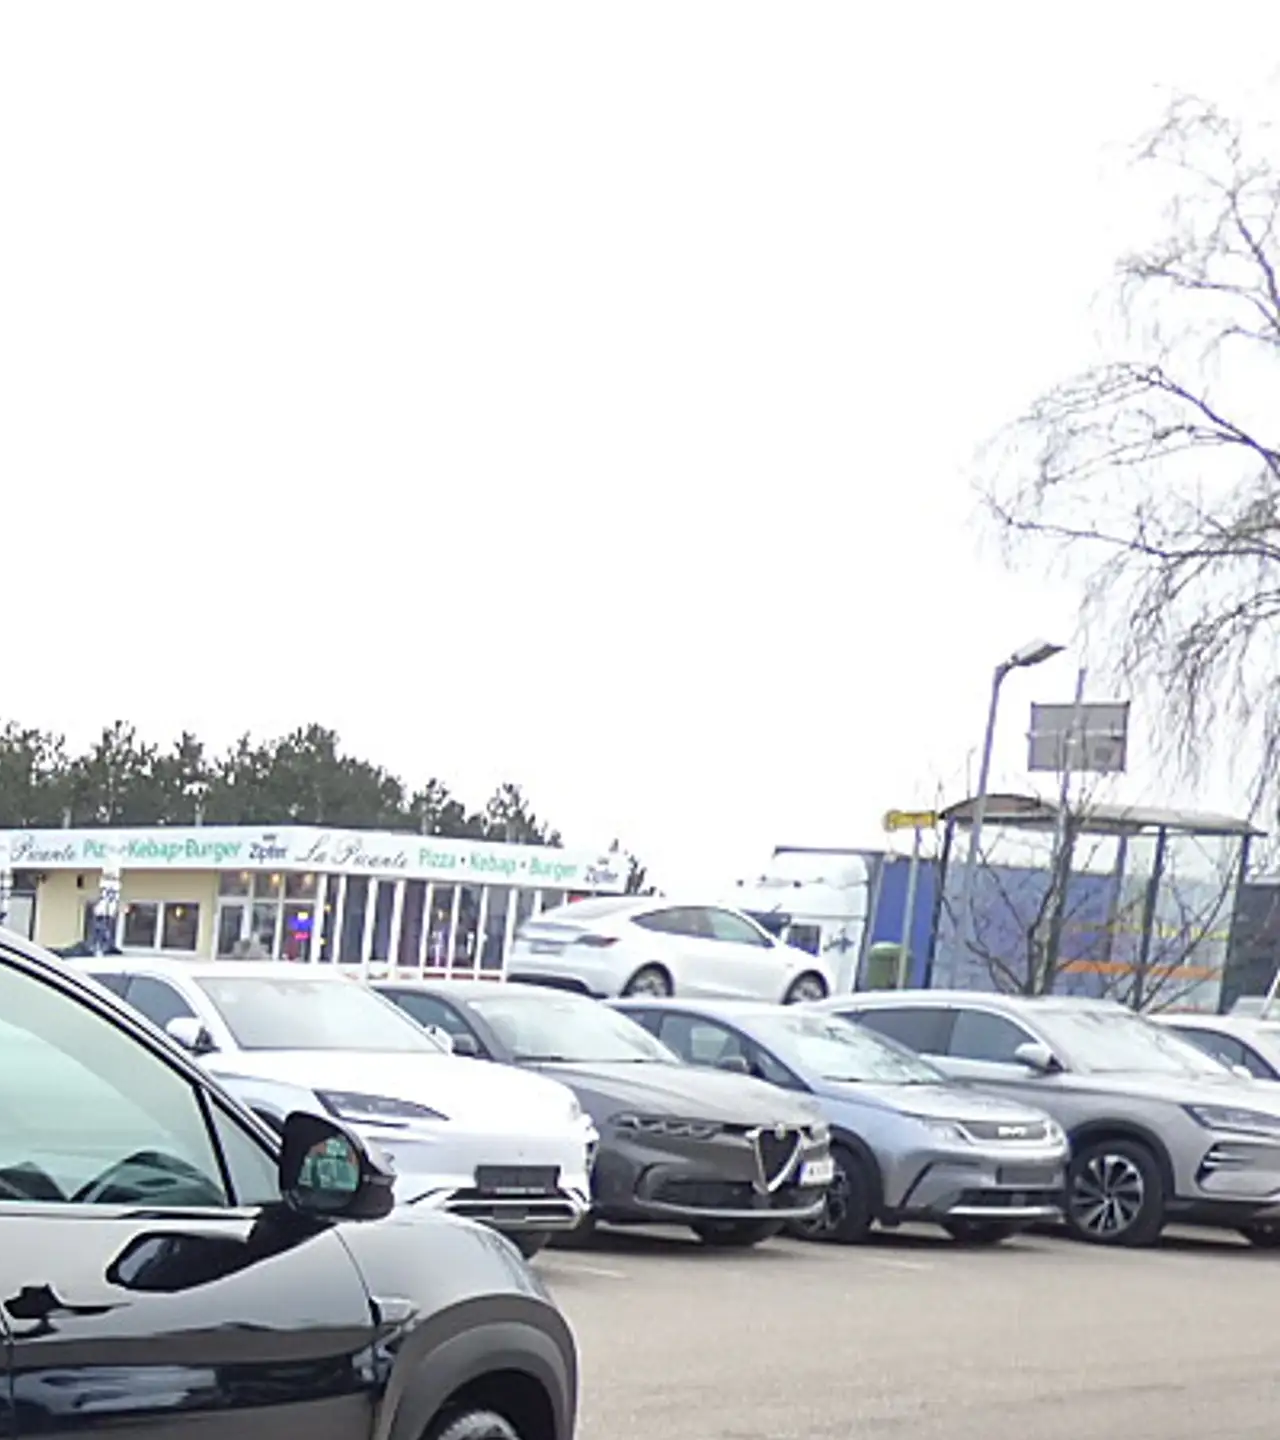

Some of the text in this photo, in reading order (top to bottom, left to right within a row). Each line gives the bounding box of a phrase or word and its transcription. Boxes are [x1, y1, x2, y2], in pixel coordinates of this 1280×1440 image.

[418, 848, 456, 869] Pizza
[469, 852, 517, 877] Kebap
[528, 857, 578, 882] Burger
